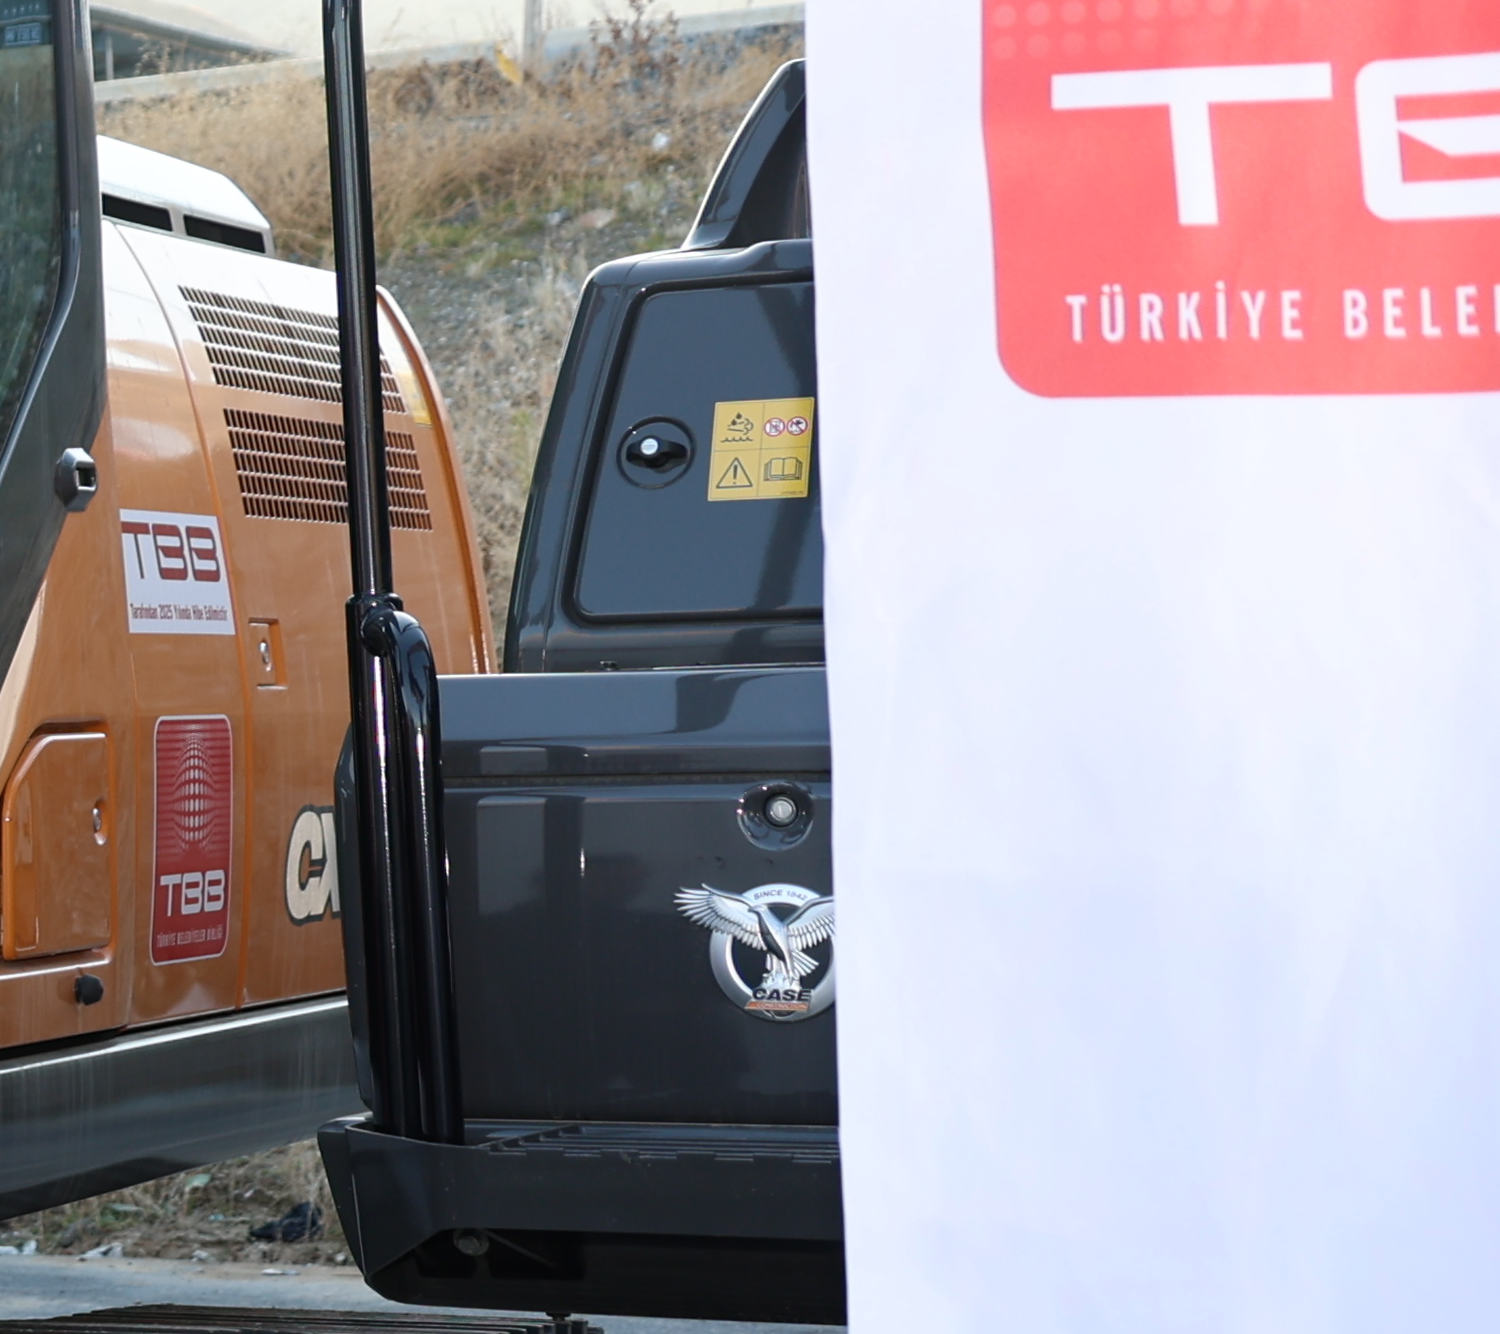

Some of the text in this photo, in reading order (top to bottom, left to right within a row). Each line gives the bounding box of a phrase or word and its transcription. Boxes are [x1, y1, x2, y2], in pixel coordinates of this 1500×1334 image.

[1066, 280, 1500, 343] TÜRKİYE BELE
[120, 521, 221, 582] TBB
[160, 869, 226, 917] TBB
[753, 889, 783, 901] SINCE
[752, 988, 812, 1002] CASE
